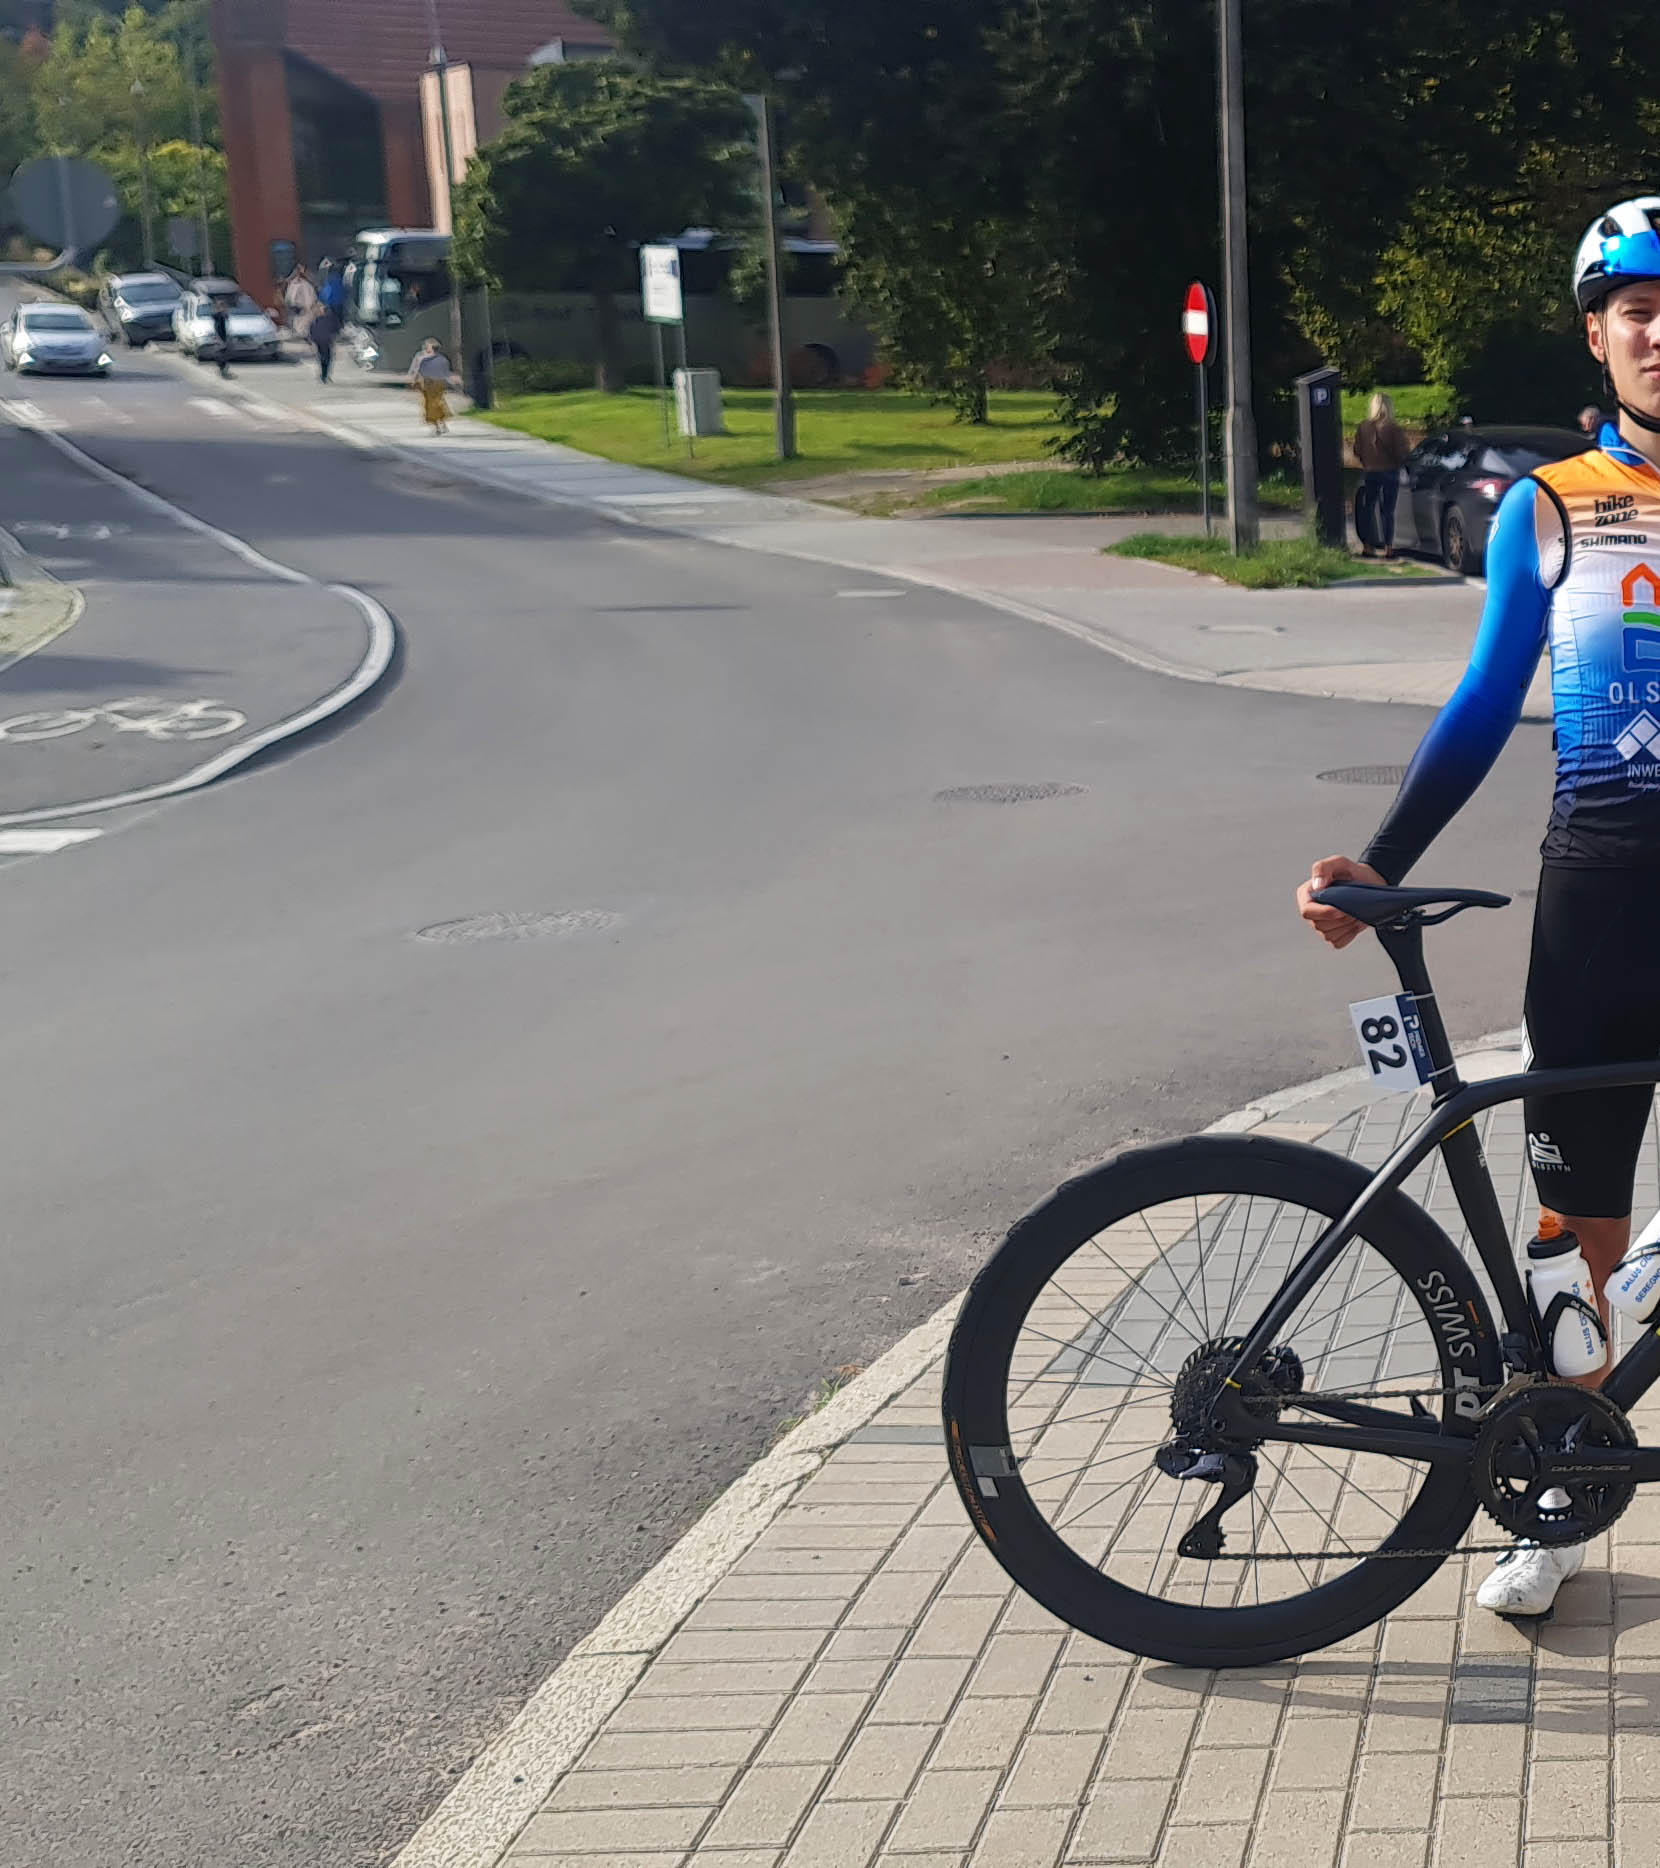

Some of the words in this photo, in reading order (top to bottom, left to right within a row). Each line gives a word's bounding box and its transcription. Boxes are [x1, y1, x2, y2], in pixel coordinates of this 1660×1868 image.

[1594, 495, 1635, 514] bike
[1594, 509, 1639, 528] zone
[1580, 534, 1648, 547] SHIMANO
[1361, 1016, 1408, 1075] 82
[1621, 1267, 1642, 1292] SALUS
[1417, 1270, 1476, 1358] SWISS
[1454, 1367, 1481, 1418] DT
